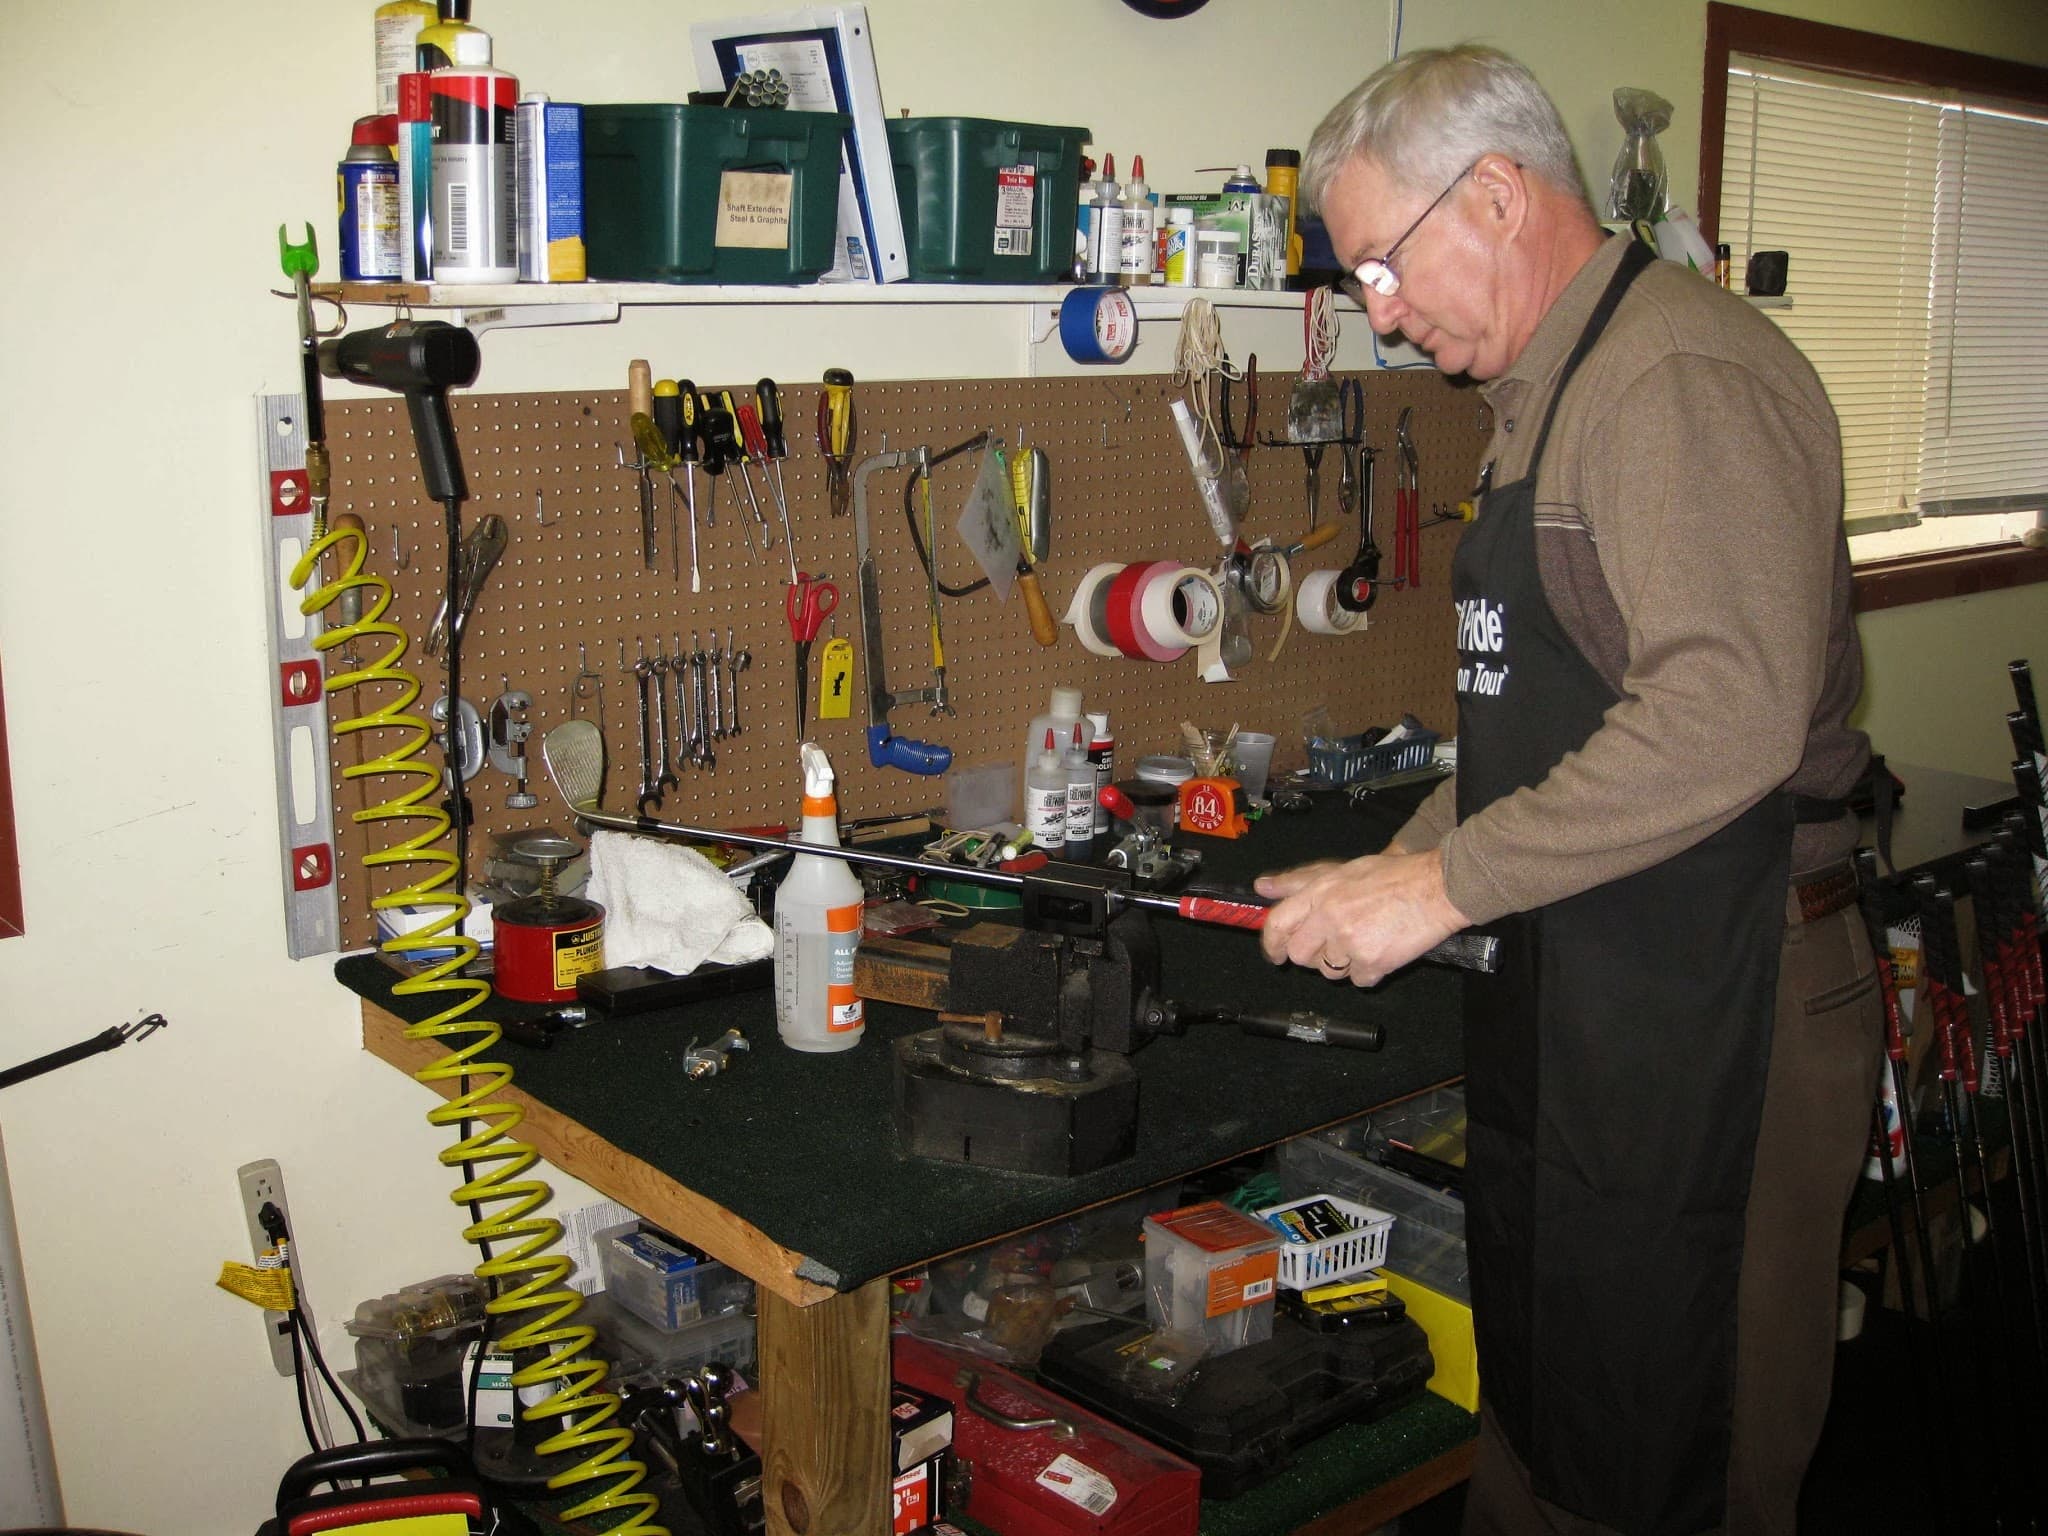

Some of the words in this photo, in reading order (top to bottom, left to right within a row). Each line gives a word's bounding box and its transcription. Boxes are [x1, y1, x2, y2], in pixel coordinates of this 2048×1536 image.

[727, 203, 746, 213] Shaft
[747, 204, 783, 214] Extenders
[730, 214, 748, 224] Steel
[749, 215, 755, 224] &
[757, 215, 788, 225] Graphite
[1457, 668, 1470, 692] on
[1472, 662, 1505, 696] Tour
[1195, 795, 1216, 818] 84
[1187, 809, 1224, 830] LUMBER
